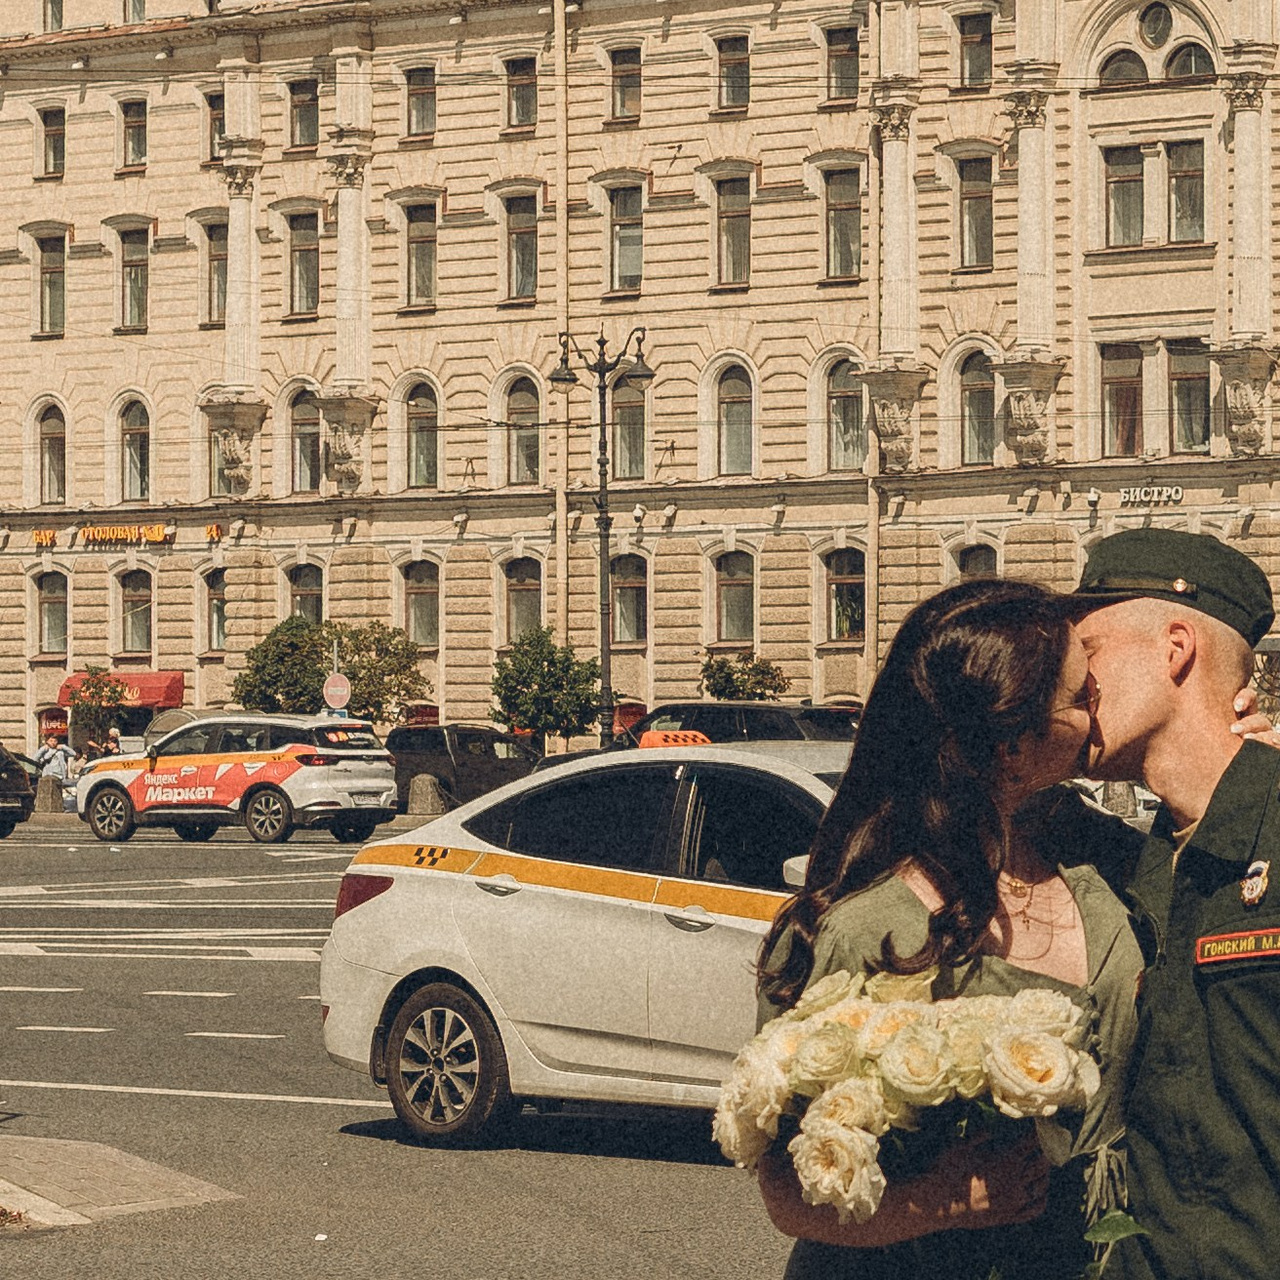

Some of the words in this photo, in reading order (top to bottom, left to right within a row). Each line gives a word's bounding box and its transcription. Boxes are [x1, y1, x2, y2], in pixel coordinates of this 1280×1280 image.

[1119, 486, 1184, 503] БИСТРО
[32, 530, 56, 543] БАР
[144, 773, 178, 786] Яндекс
[145, 786, 216, 803] Маркет
[1204, 936, 1256, 957] ГОНСКИЙ
